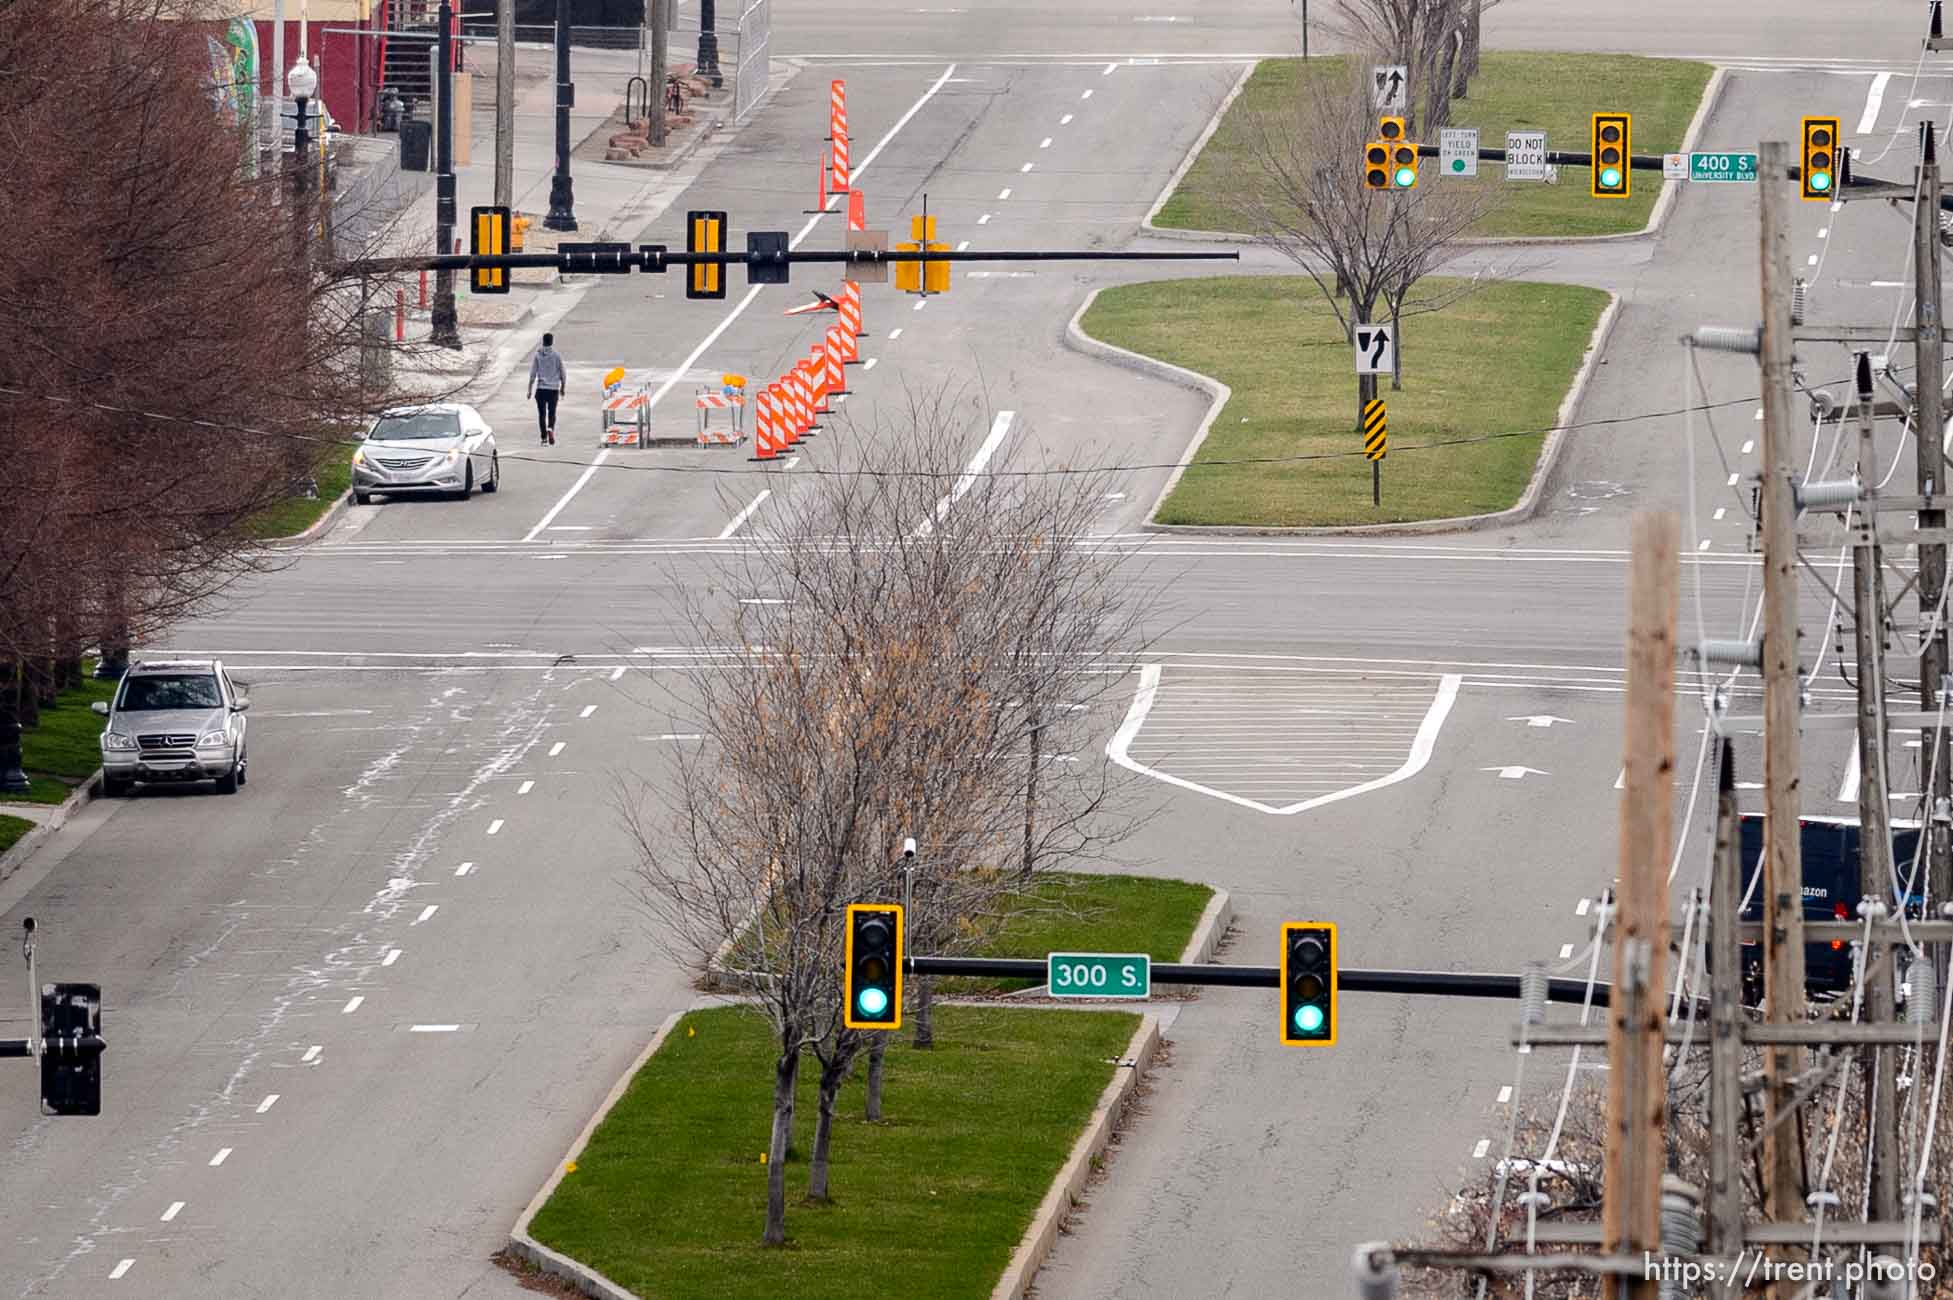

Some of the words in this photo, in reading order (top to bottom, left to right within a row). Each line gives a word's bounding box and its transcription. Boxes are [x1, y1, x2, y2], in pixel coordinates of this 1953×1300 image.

[1447, 140, 1471, 149] YIELD
[1508, 138, 1521, 149] DO
[1525, 138, 1543, 149] NOT
[1508, 153, 1543, 165] BLOCK
[1697, 156, 1730, 171] 400
[1738, 156, 1752, 171] S.
[1056, 963, 1107, 987] 300
[1120, 964, 1143, 987] S.
